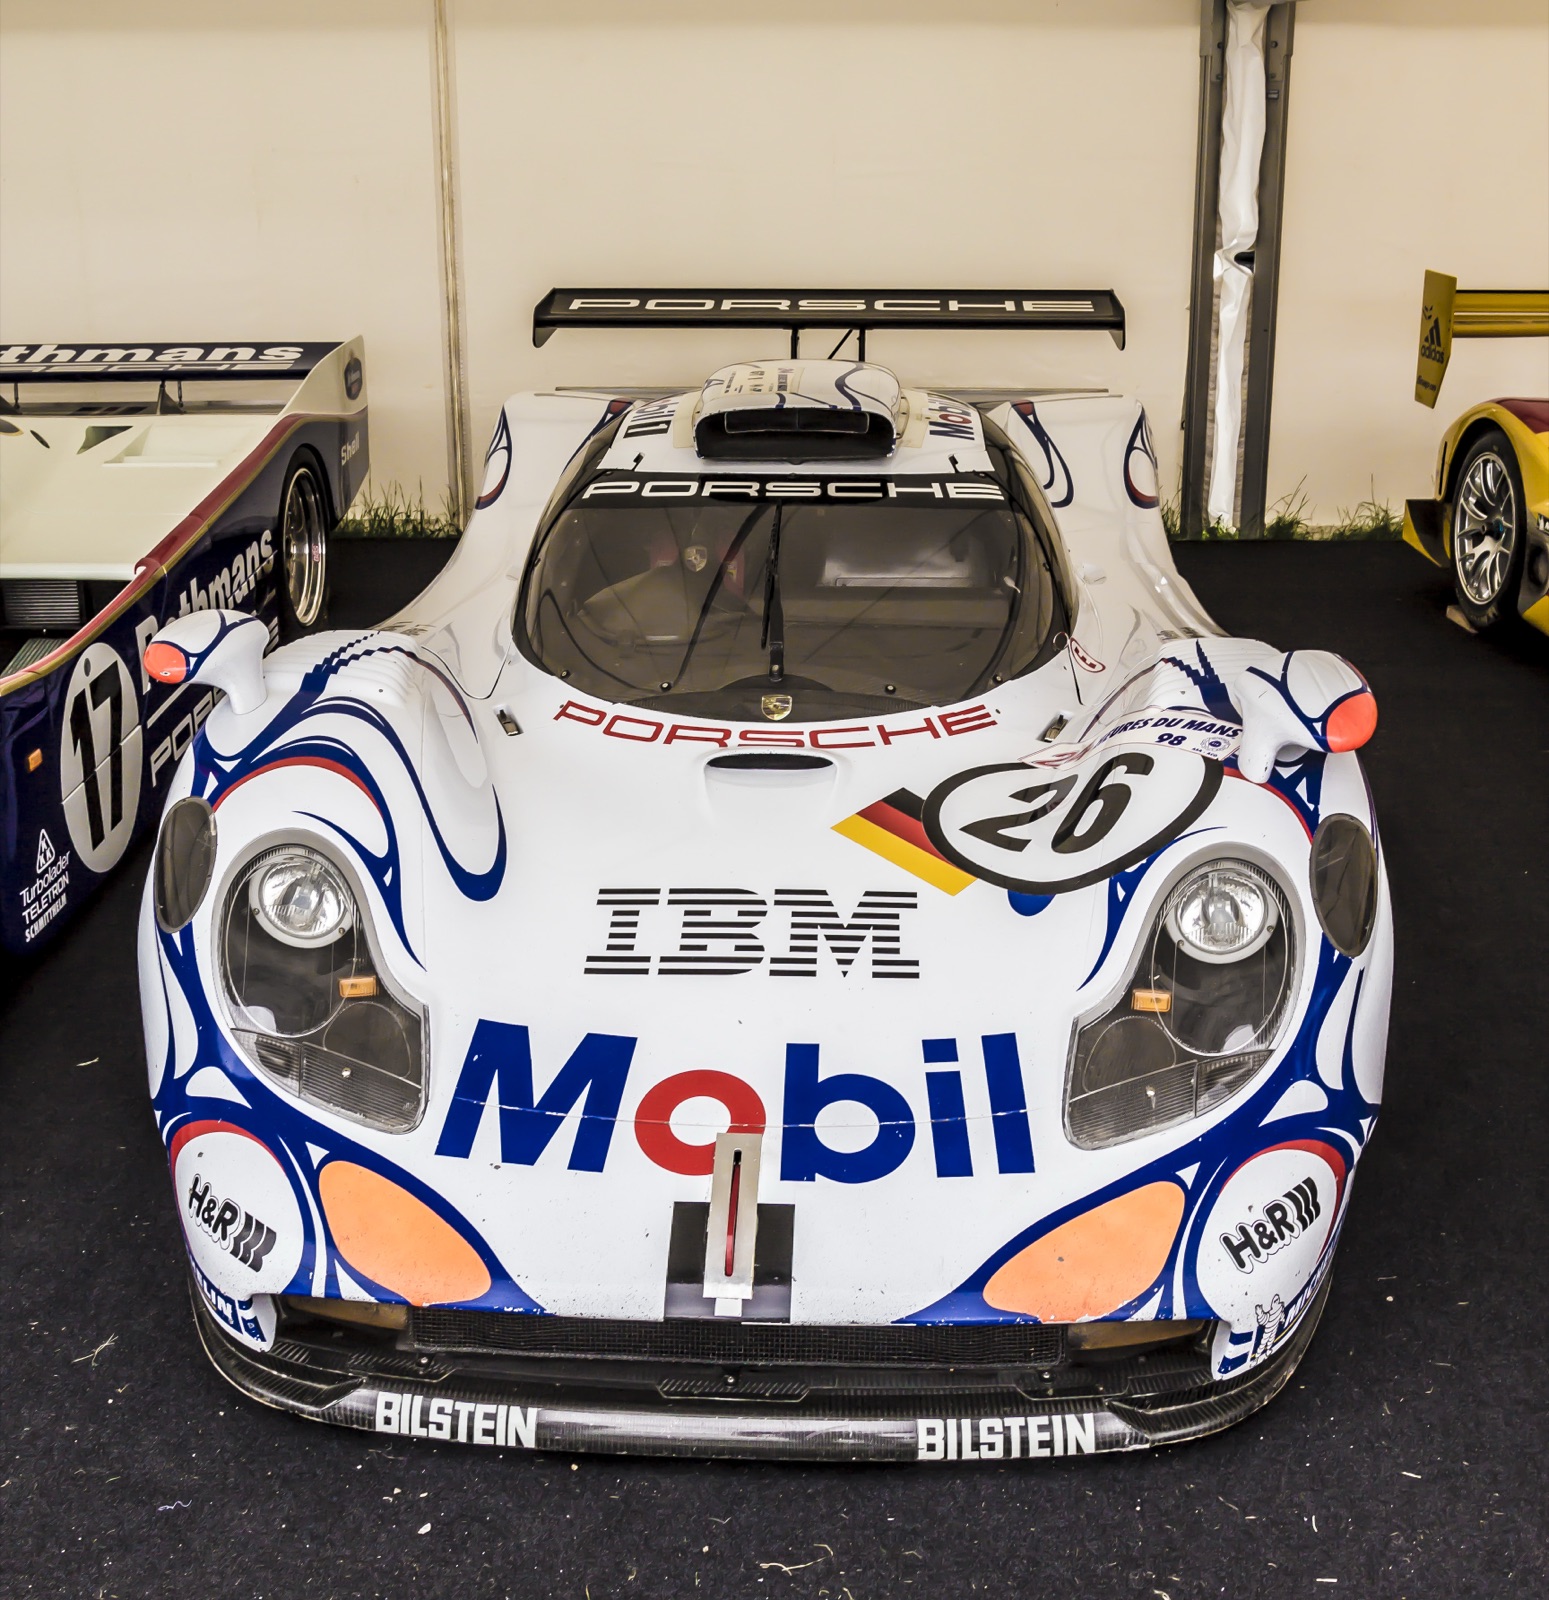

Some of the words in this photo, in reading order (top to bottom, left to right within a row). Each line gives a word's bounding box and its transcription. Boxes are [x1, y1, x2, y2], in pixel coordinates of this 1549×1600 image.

[568, 298, 1095, 312] PORSCHE
[1421, 344, 1445, 364] adidas
[341, 431, 360, 466] Shell
[582, 480, 1004, 500] PORSCHE
[554, 700, 998, 749] PORSCHE
[1150, 717, 1185, 728] DU
[1180, 719, 1243, 738] MANS
[1155, 733, 1187, 746] 98
[69, 660, 123, 851] 17
[962, 752, 1155, 854] 26
[20, 851, 70, 907] Turbolader
[22, 871, 69, 925] TELETRON
[584, 888, 920, 979] IBM
[434, 1018, 1035, 1184] Mobil
[188, 1176, 238, 1242] H&R
[1222, 1202, 1295, 1269] H&R
[374, 1392, 538, 1449] BILSTEIN
[917, 1413, 1096, 1461] BILSTEIN
